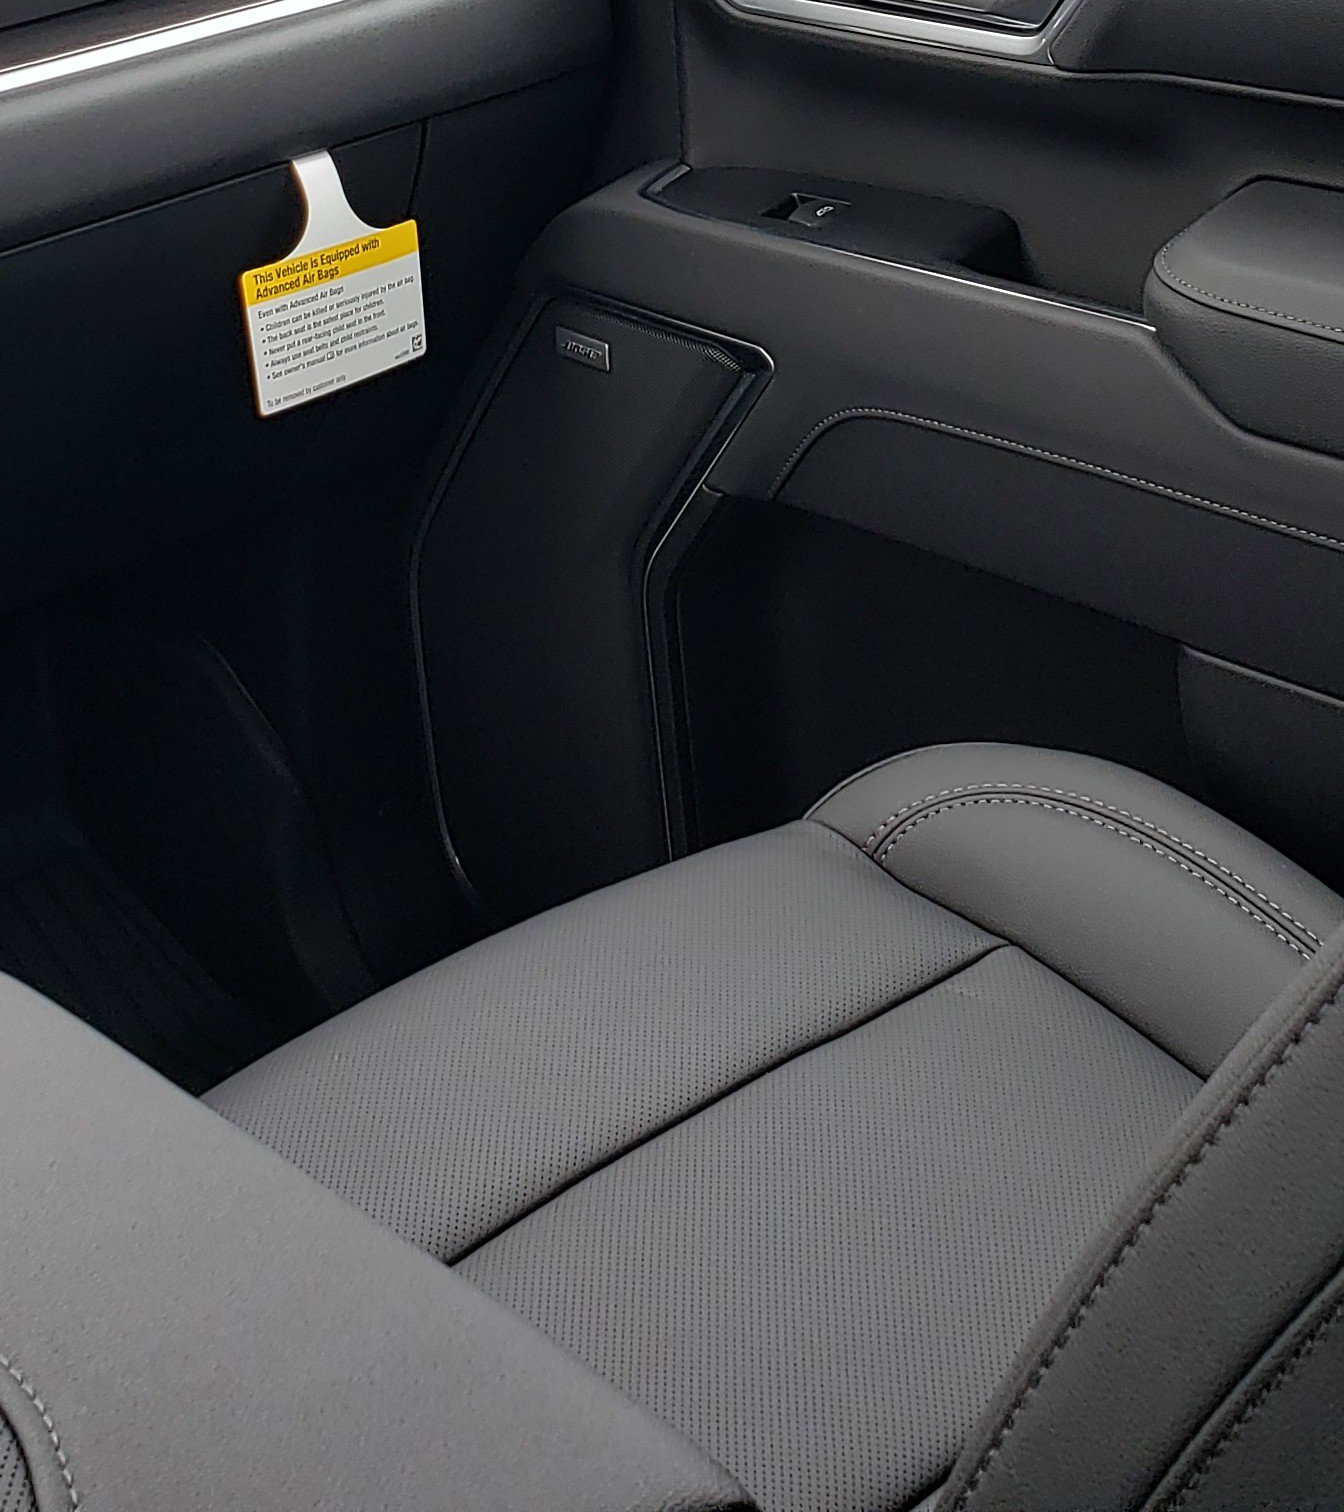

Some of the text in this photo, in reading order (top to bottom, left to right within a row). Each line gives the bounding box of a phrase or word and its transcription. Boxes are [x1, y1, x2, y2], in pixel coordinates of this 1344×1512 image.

[253, 271, 273, 285] This
[275, 262, 308, 278] Vehicle
[320, 244, 359, 265] Equipped
[361, 238, 380, 252] with
[256, 266, 340, 300] Advanced Air Bags
[258, 309, 273, 319] Even
[275, 304, 288, 314] with
[290, 294, 318, 309] Advanced
[266, 319, 290, 331] Children
[292, 314, 302, 323] can
[312, 305, 328, 316] killed
[267, 334, 277, 343] The
[279, 329, 292, 339] back
